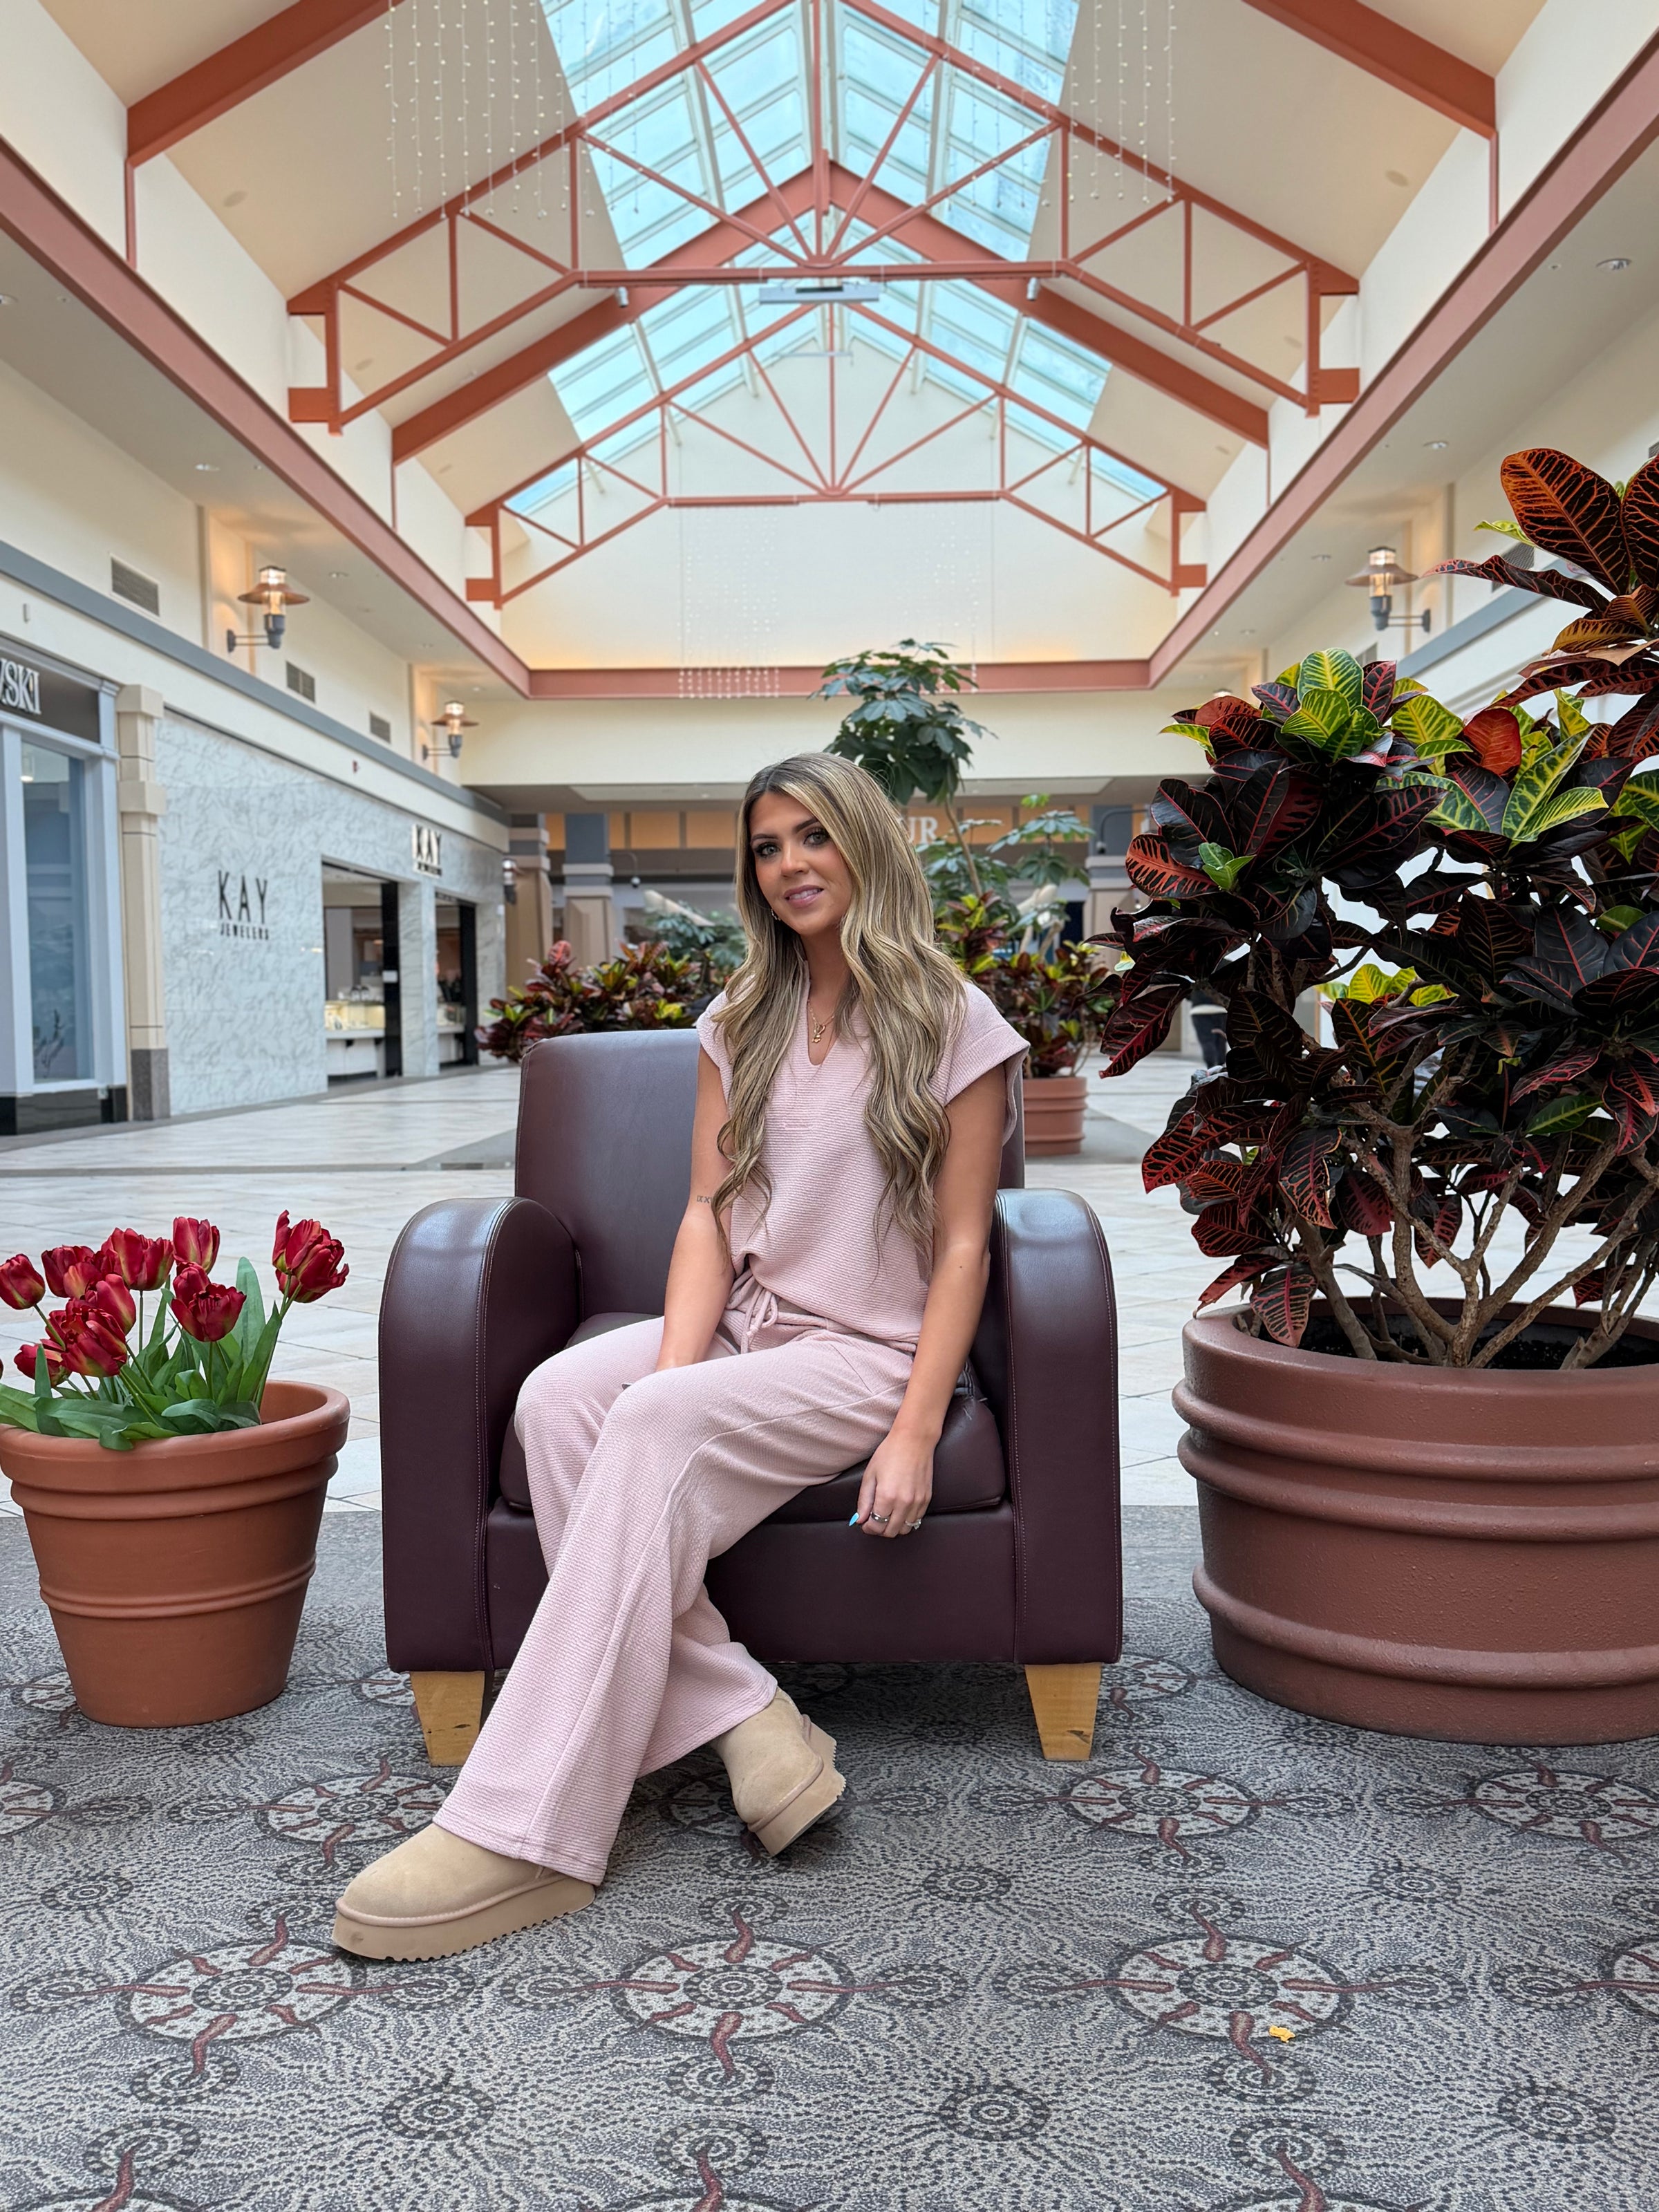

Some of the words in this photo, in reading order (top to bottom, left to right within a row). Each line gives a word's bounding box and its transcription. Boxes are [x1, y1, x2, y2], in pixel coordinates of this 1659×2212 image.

[415, 823, 442, 865] KAY
[218, 870, 268, 924] KAY
[220, 923, 269, 940] JEWELERS
